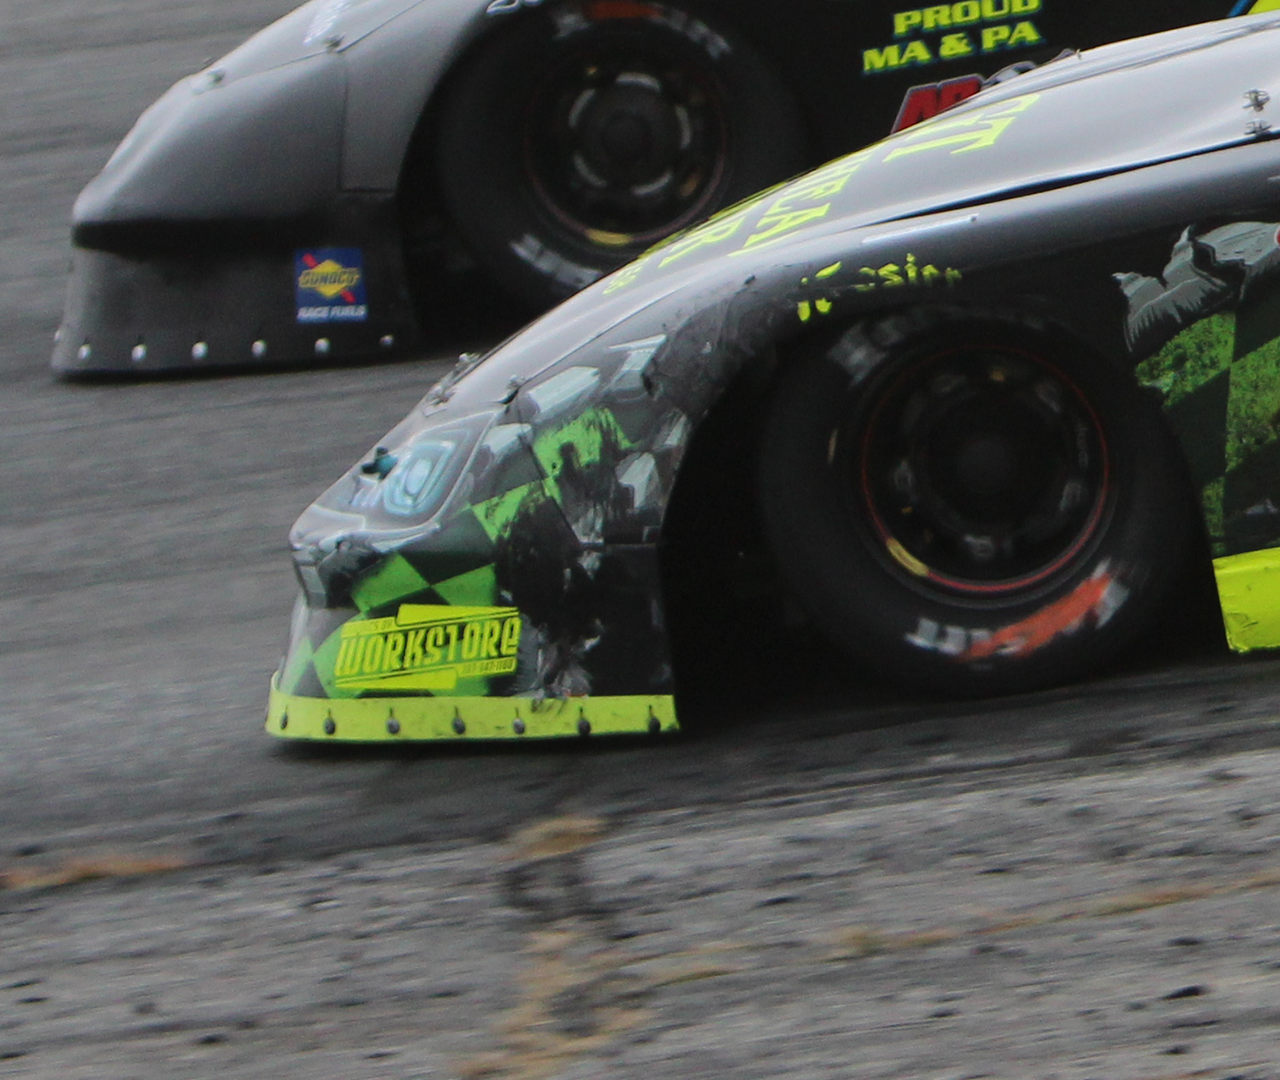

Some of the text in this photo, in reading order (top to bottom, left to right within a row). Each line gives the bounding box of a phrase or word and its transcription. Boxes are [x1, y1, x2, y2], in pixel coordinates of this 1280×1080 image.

[862, 20, 1042, 73] MA & PA
[298, 267, 361, 288] SUNOCO
